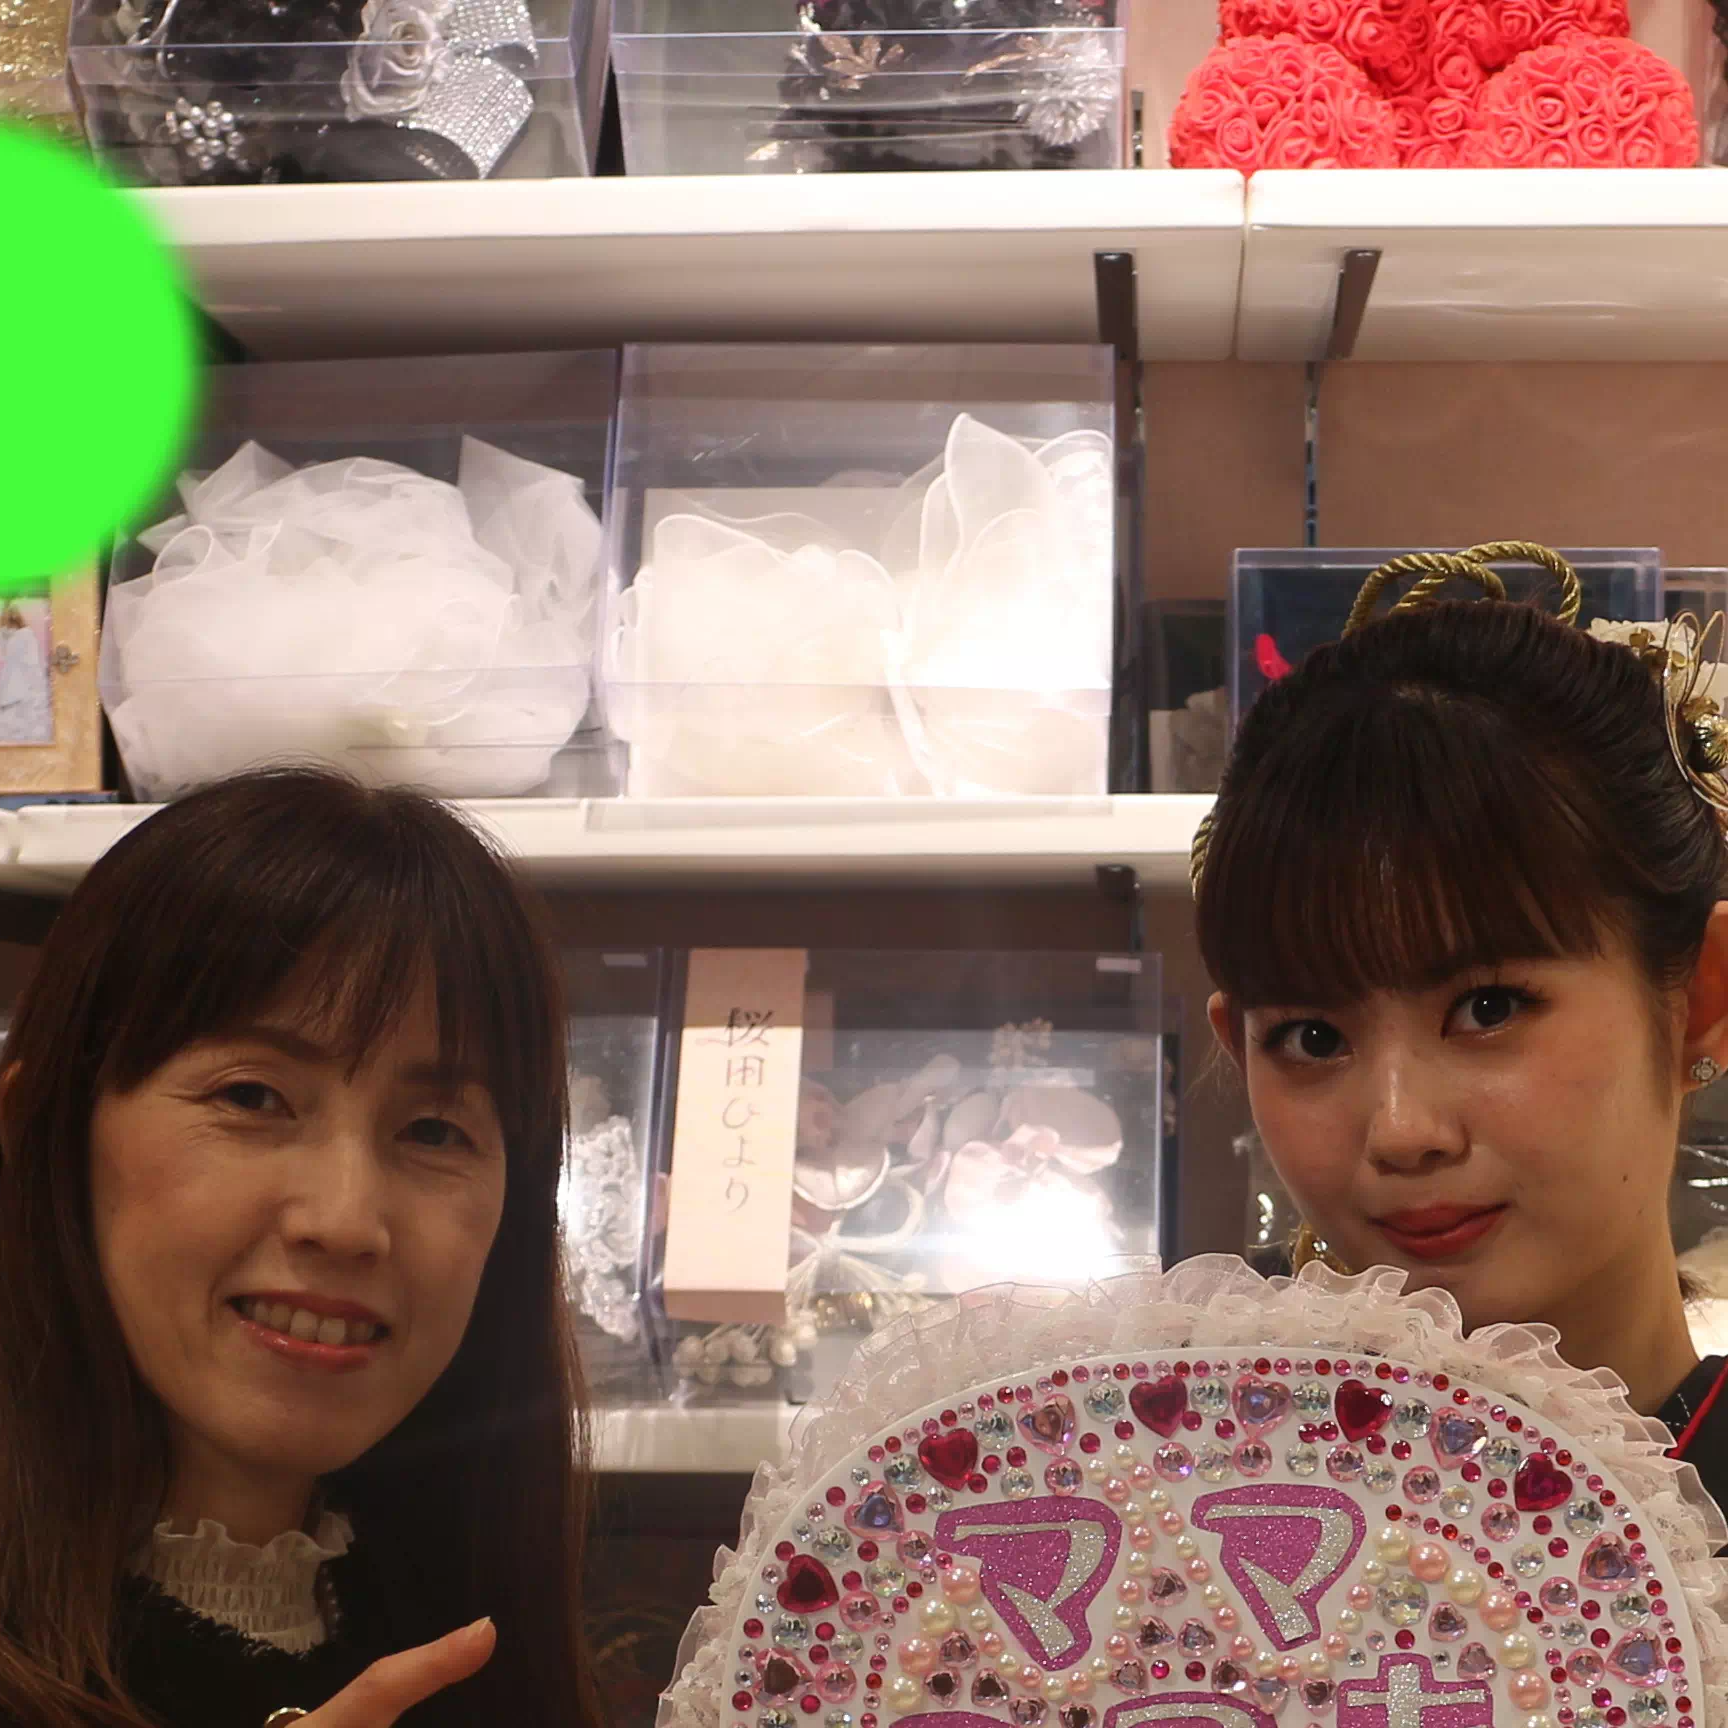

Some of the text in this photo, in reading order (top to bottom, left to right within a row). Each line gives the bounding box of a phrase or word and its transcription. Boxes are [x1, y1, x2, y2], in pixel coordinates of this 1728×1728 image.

[694, 1006, 775, 1212] 桜田ひより
[933, 1484, 1367, 1672] ママ
